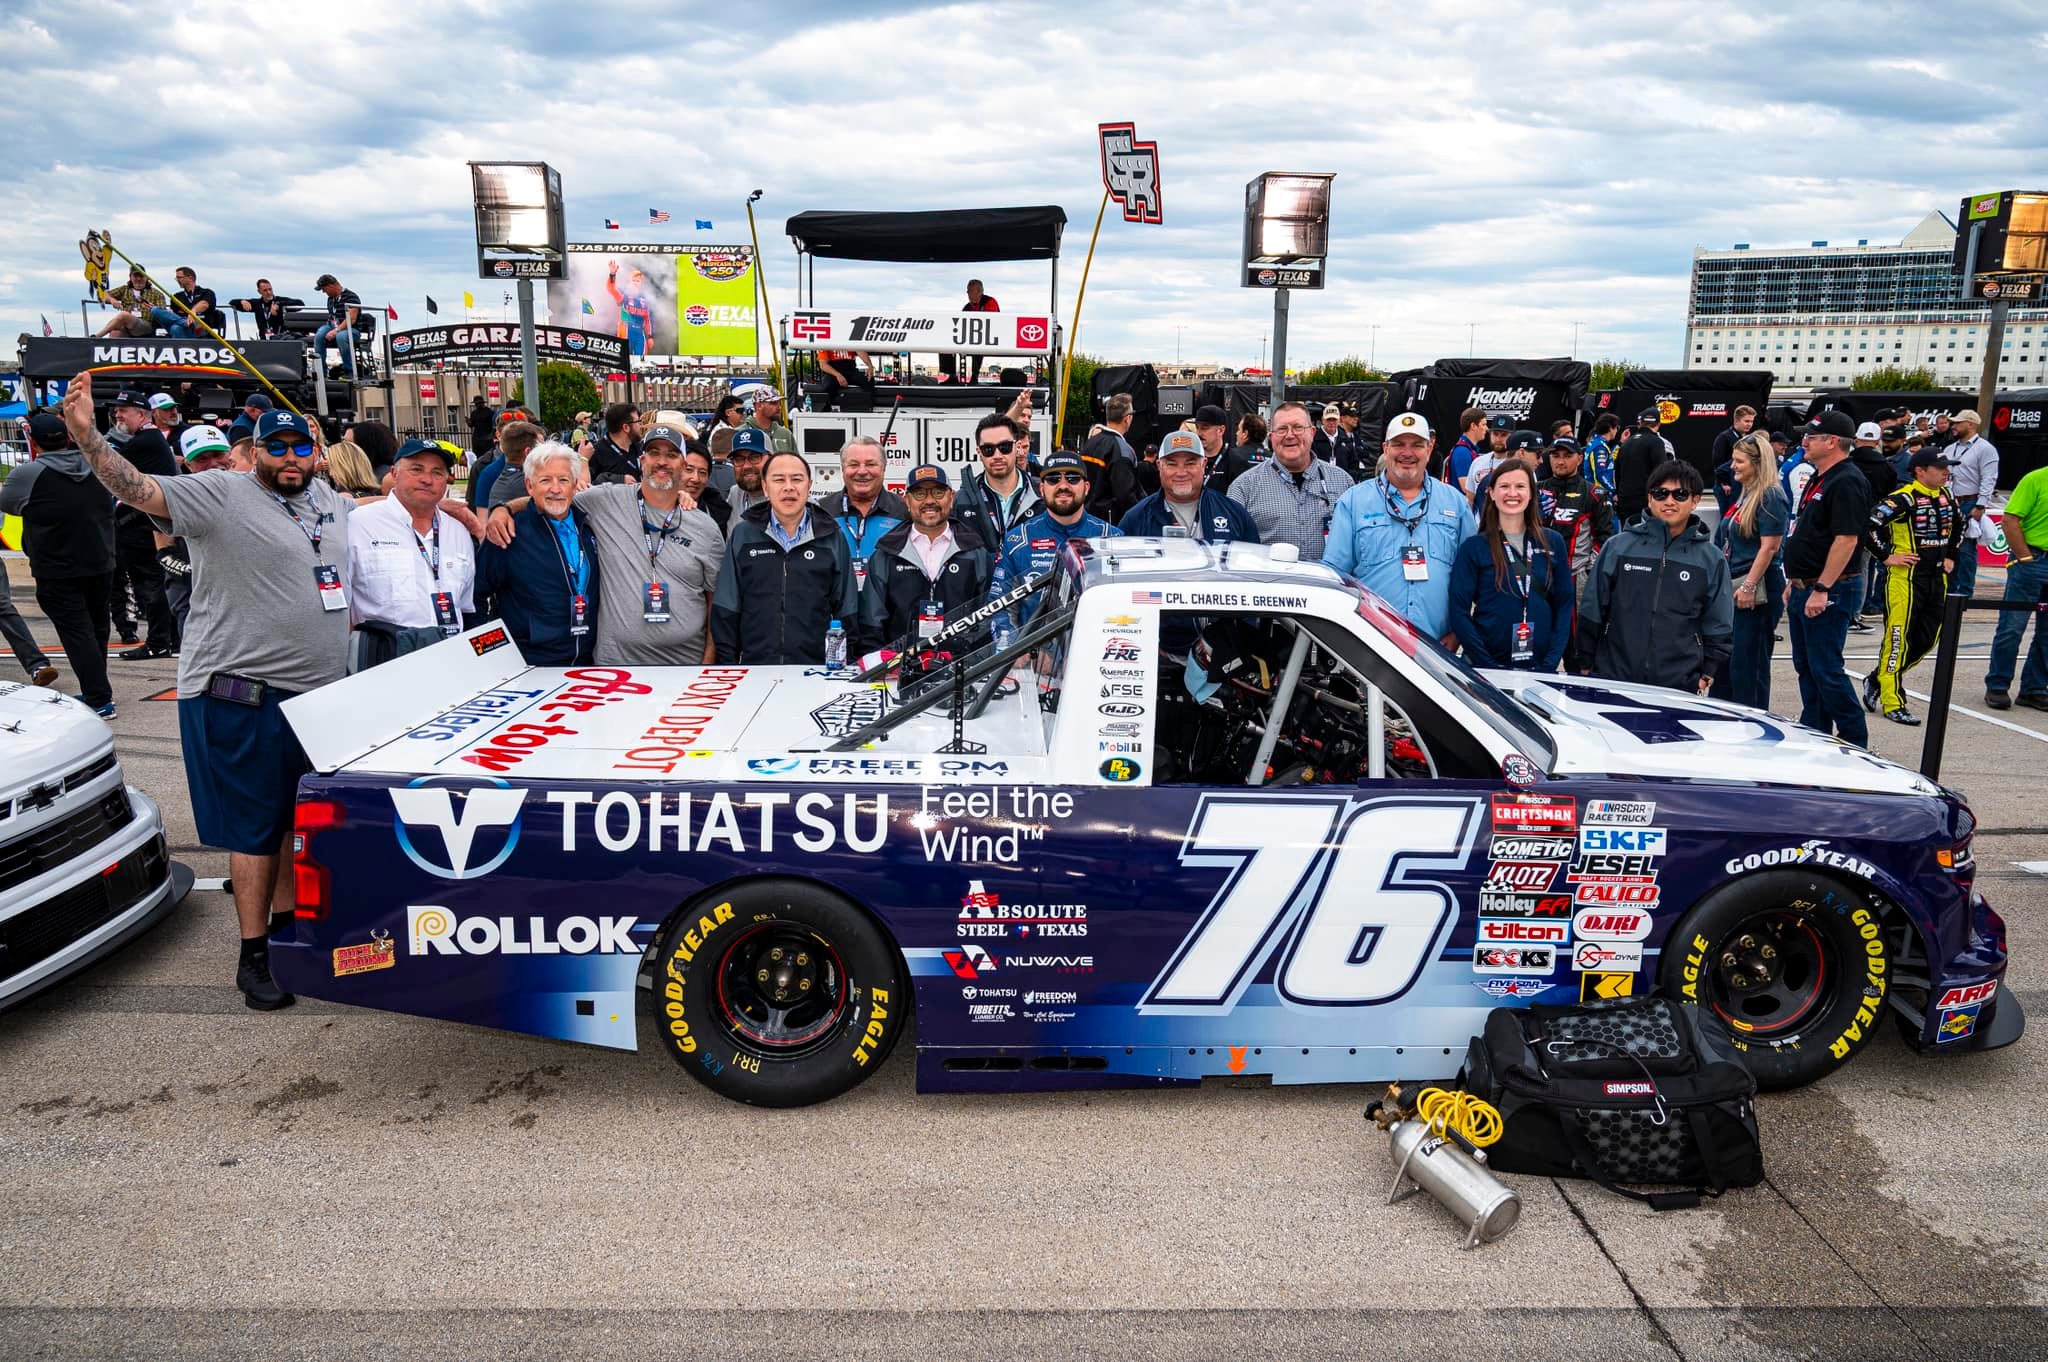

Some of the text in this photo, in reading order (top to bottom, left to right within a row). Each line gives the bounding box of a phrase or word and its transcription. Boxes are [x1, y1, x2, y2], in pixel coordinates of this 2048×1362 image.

[515, 262, 550, 273] TEXAS
[709, 267, 734, 275] 250
[1278, 271, 1311, 281] TEXAS
[2001, 283, 2032, 294] TEXAS
[870, 316, 901, 329] First
[902, 317, 934, 330] Auto
[953, 317, 999, 346] JBL
[412, 331, 448, 345] TEXAS
[452, 327, 562, 348] GARAGE
[586, 336, 622, 353] TEXAS
[865, 329, 907, 343] Group
[93, 346, 236, 365] MENARDS
[1467, 386, 1537, 407] Hendrick
[1692, 403, 1726, 411] TRACKER
[2011, 408, 2042, 422] Haas
[936, 437, 978, 462] JBL
[1165, 592, 1307, 608] CPL. CHARLES E. GREENWAY
[927, 582, 1036, 647] CHEVROLET
[1102, 647, 1142, 661] FRE
[1886, 625, 1901, 673] MENARDS
[1111, 684, 1143, 696] FSE
[407, 689, 545, 742] Trailers
[1105, 705, 1137, 715] HJC
[612, 668, 750, 774] EPOXY DEPOT
[1099, 741, 1130, 752] Mobil
[921, 785, 1074, 818] Feel the
[1524, 796, 1551, 805] NASCAR
[1608, 803, 1646, 814] NASCAR
[546, 790, 889, 854] TOHATSU
[1495, 807, 1572, 822] CRAFTSMAN
[1588, 813, 1648, 823] RACE TRUCK
[1492, 838, 1573, 857] COMETIC
[1583, 830, 1664, 851] SKF
[1568, 855, 1655, 876] JESEL
[1492, 865, 1553, 886] KLOTZ
[958, 880, 1087, 919] ABSOLUTE
[1577, 885, 1659, 902] CALICO
[1135, 792, 1486, 1017] 76
[1480, 894, 1536, 916] Holley
[407, 905, 639, 956] ROLLOK
[957, 924, 1088, 937] STEEL TEXAS
[1484, 922, 1564, 941] tilton
[1005, 956, 1094, 967] NUWAVE
[1476, 948, 1551, 968] KOOKS
[1682, 933, 1710, 1005] AGLE
[1488, 979, 1541, 988] FIVE STAR
[979, 988, 1017, 997] TOHATSU
[1035, 992, 1077, 1000] FREEDOM
[1942, 980, 1996, 1007] ARP
[968, 1005, 1011, 1015] TIBBETTS
[852, 987, 889, 1067] EAGLE
[1606, 1083, 1654, 1094] SIMPSON
